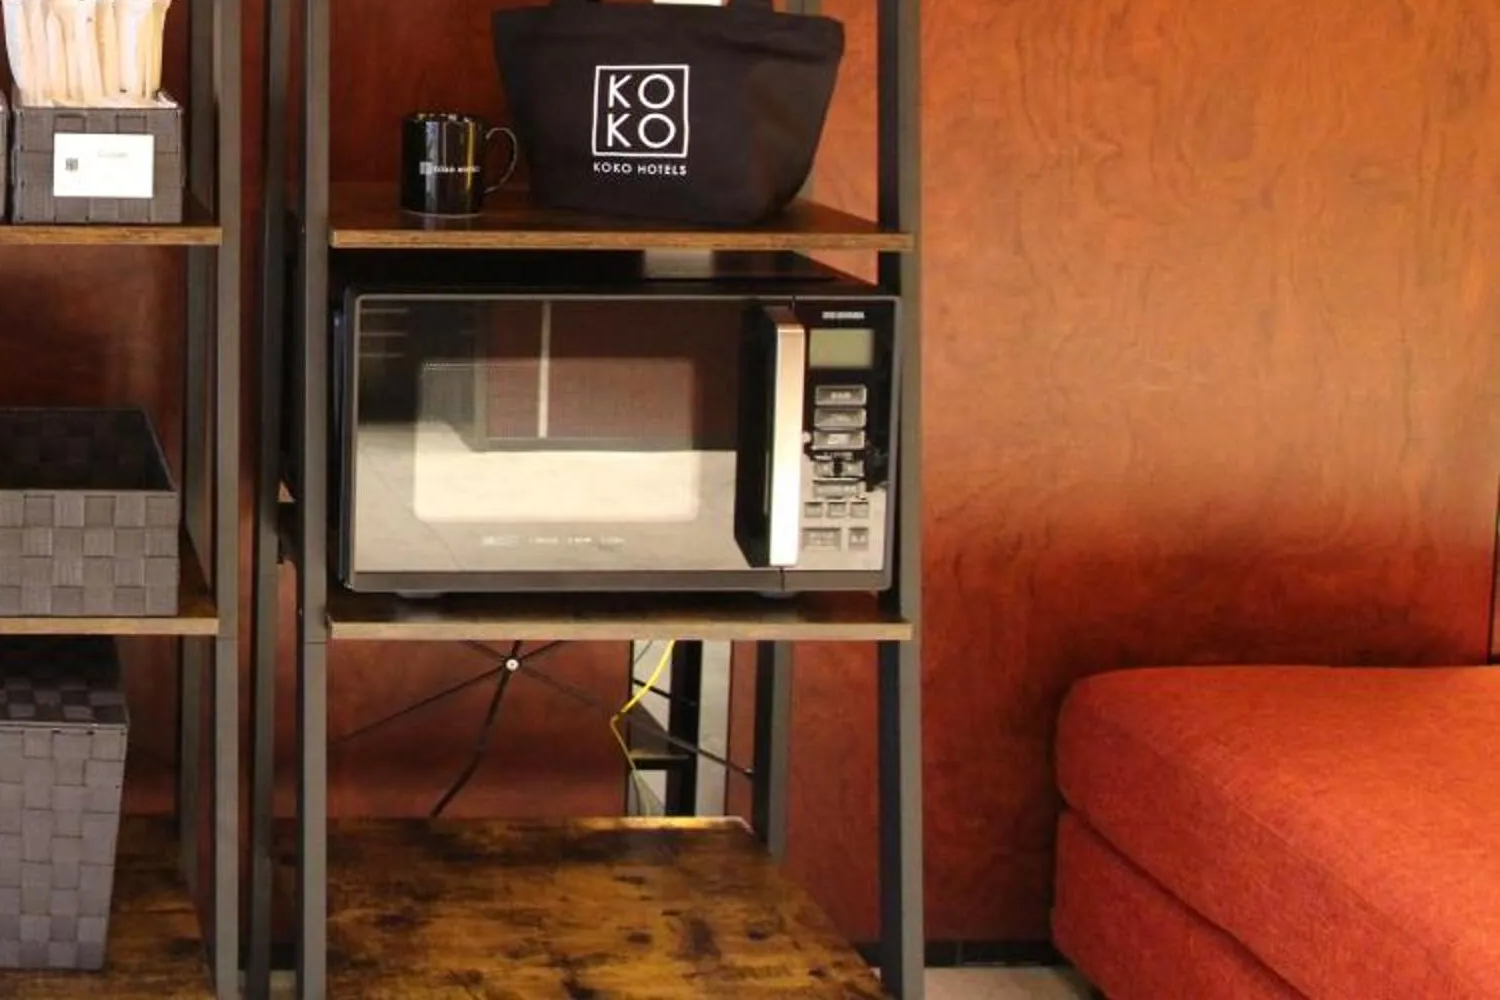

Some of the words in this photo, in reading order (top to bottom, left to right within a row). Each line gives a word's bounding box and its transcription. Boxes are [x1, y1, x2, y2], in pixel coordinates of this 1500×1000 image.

[607, 73, 675, 109] KO
[607, 112, 676, 149] KO
[593, 162, 632, 174] KOKO
[637, 163, 687, 176] HOTELS
